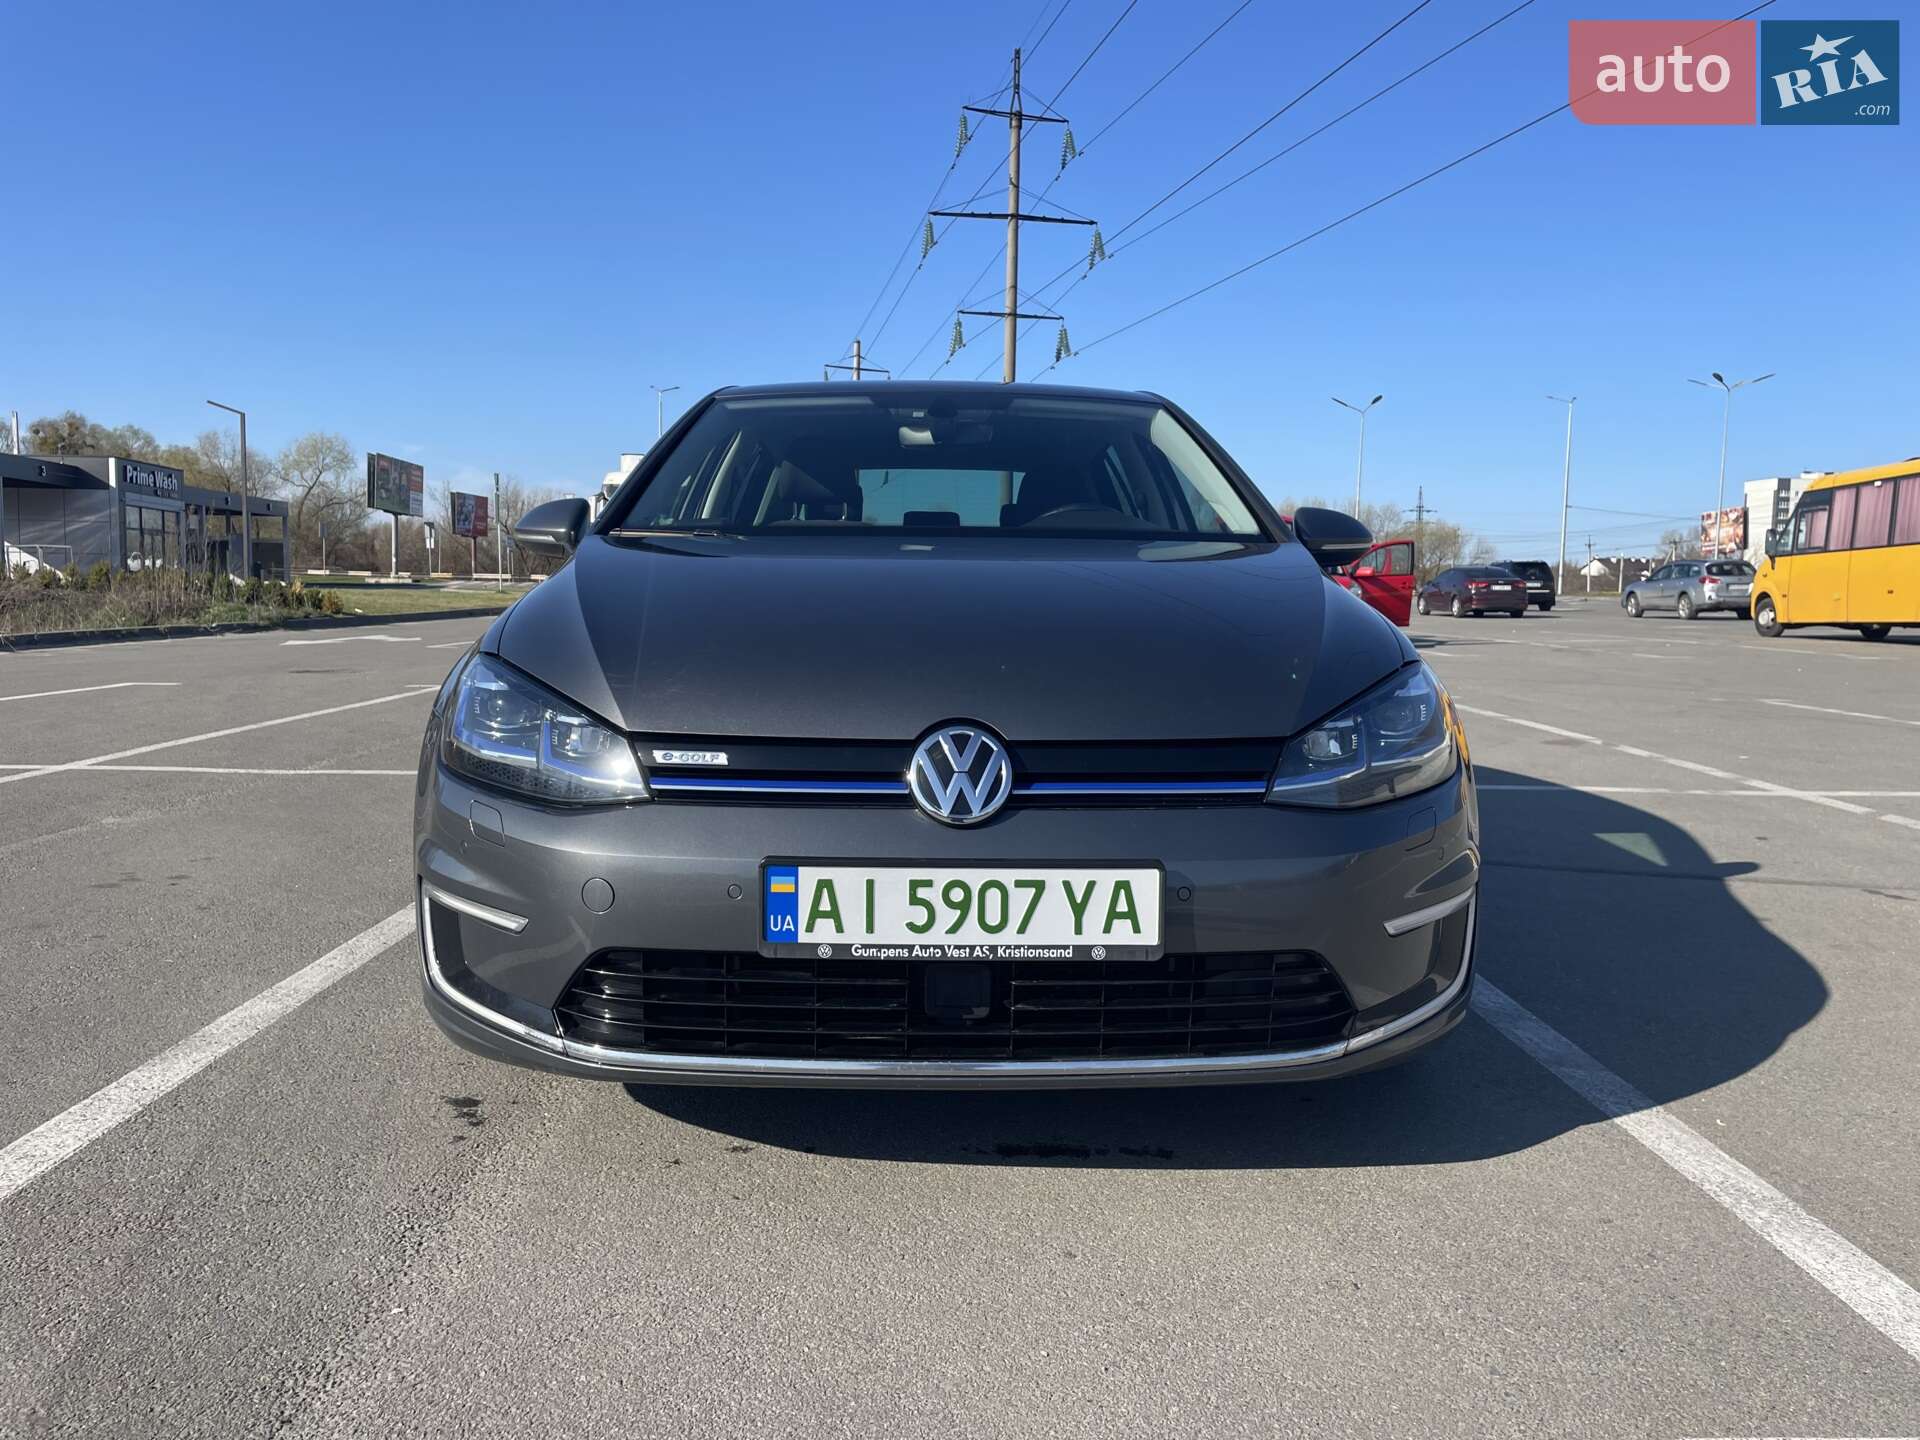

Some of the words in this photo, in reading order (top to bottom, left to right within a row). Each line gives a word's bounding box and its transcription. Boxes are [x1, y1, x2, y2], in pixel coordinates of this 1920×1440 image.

[41, 465, 46, 477] 3
[126, 464, 154, 487] Prime
[154, 470, 178, 491] Wash
[905, 879, 1046, 935] 5907
[1062, 879, 1142, 935] YA
[770, 914, 795, 932] UA
[911, 945, 941, 957] Auto
[944, 945, 970, 958] Vest
[997, 945, 1073, 958] Kristiansand
